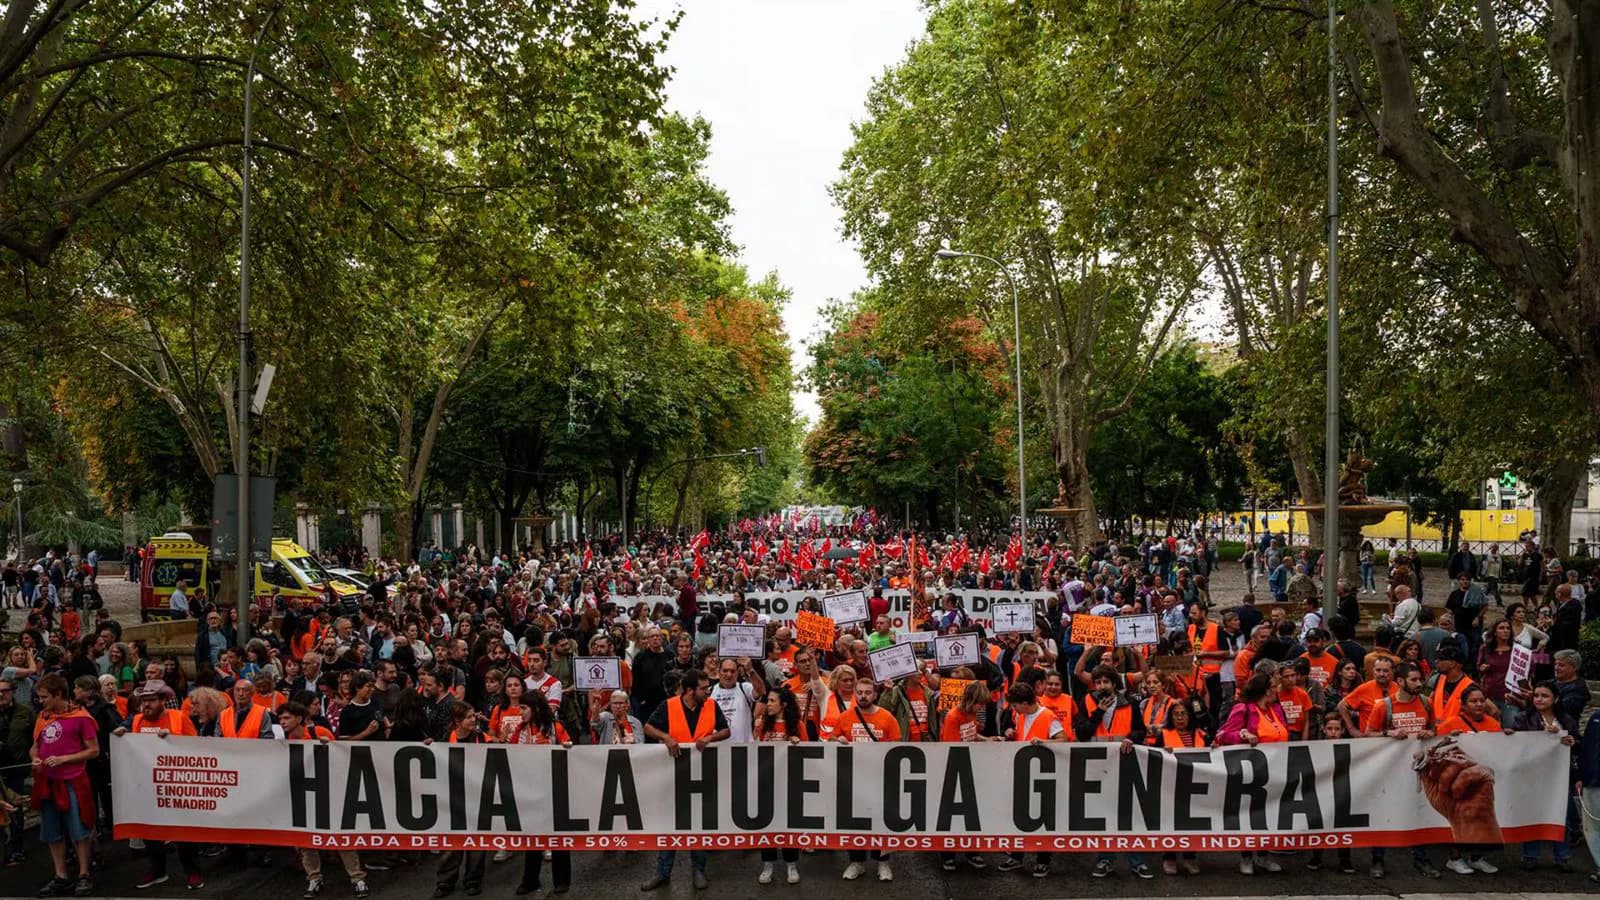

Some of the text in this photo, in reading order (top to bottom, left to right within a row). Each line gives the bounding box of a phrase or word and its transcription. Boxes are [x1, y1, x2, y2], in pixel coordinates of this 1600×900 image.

[156, 755, 218, 768] SINDICATO
[156, 770, 236, 784] DE INQUILINAS
[156, 785, 228, 799] E INQUILINOS
[289, 743, 1370, 833] HACIA LA HUELGA GENERAL
[157, 798, 217, 811] DE MADRID
[311, 835, 400, 848] BAJADA
[411, 835, 453, 848] DEL
[463, 836, 576, 849] ALQUILER
[585, 836, 628, 848] 50%
[657, 832, 829, 848] EXPROPIACIÓN
[840, 834, 933, 848] FONDOS
[943, 836, 1025, 849] BUITRE
[1053, 836, 1191, 849] CONTRATOS
[1201, 833, 1354, 849] INDEFINIDOS
